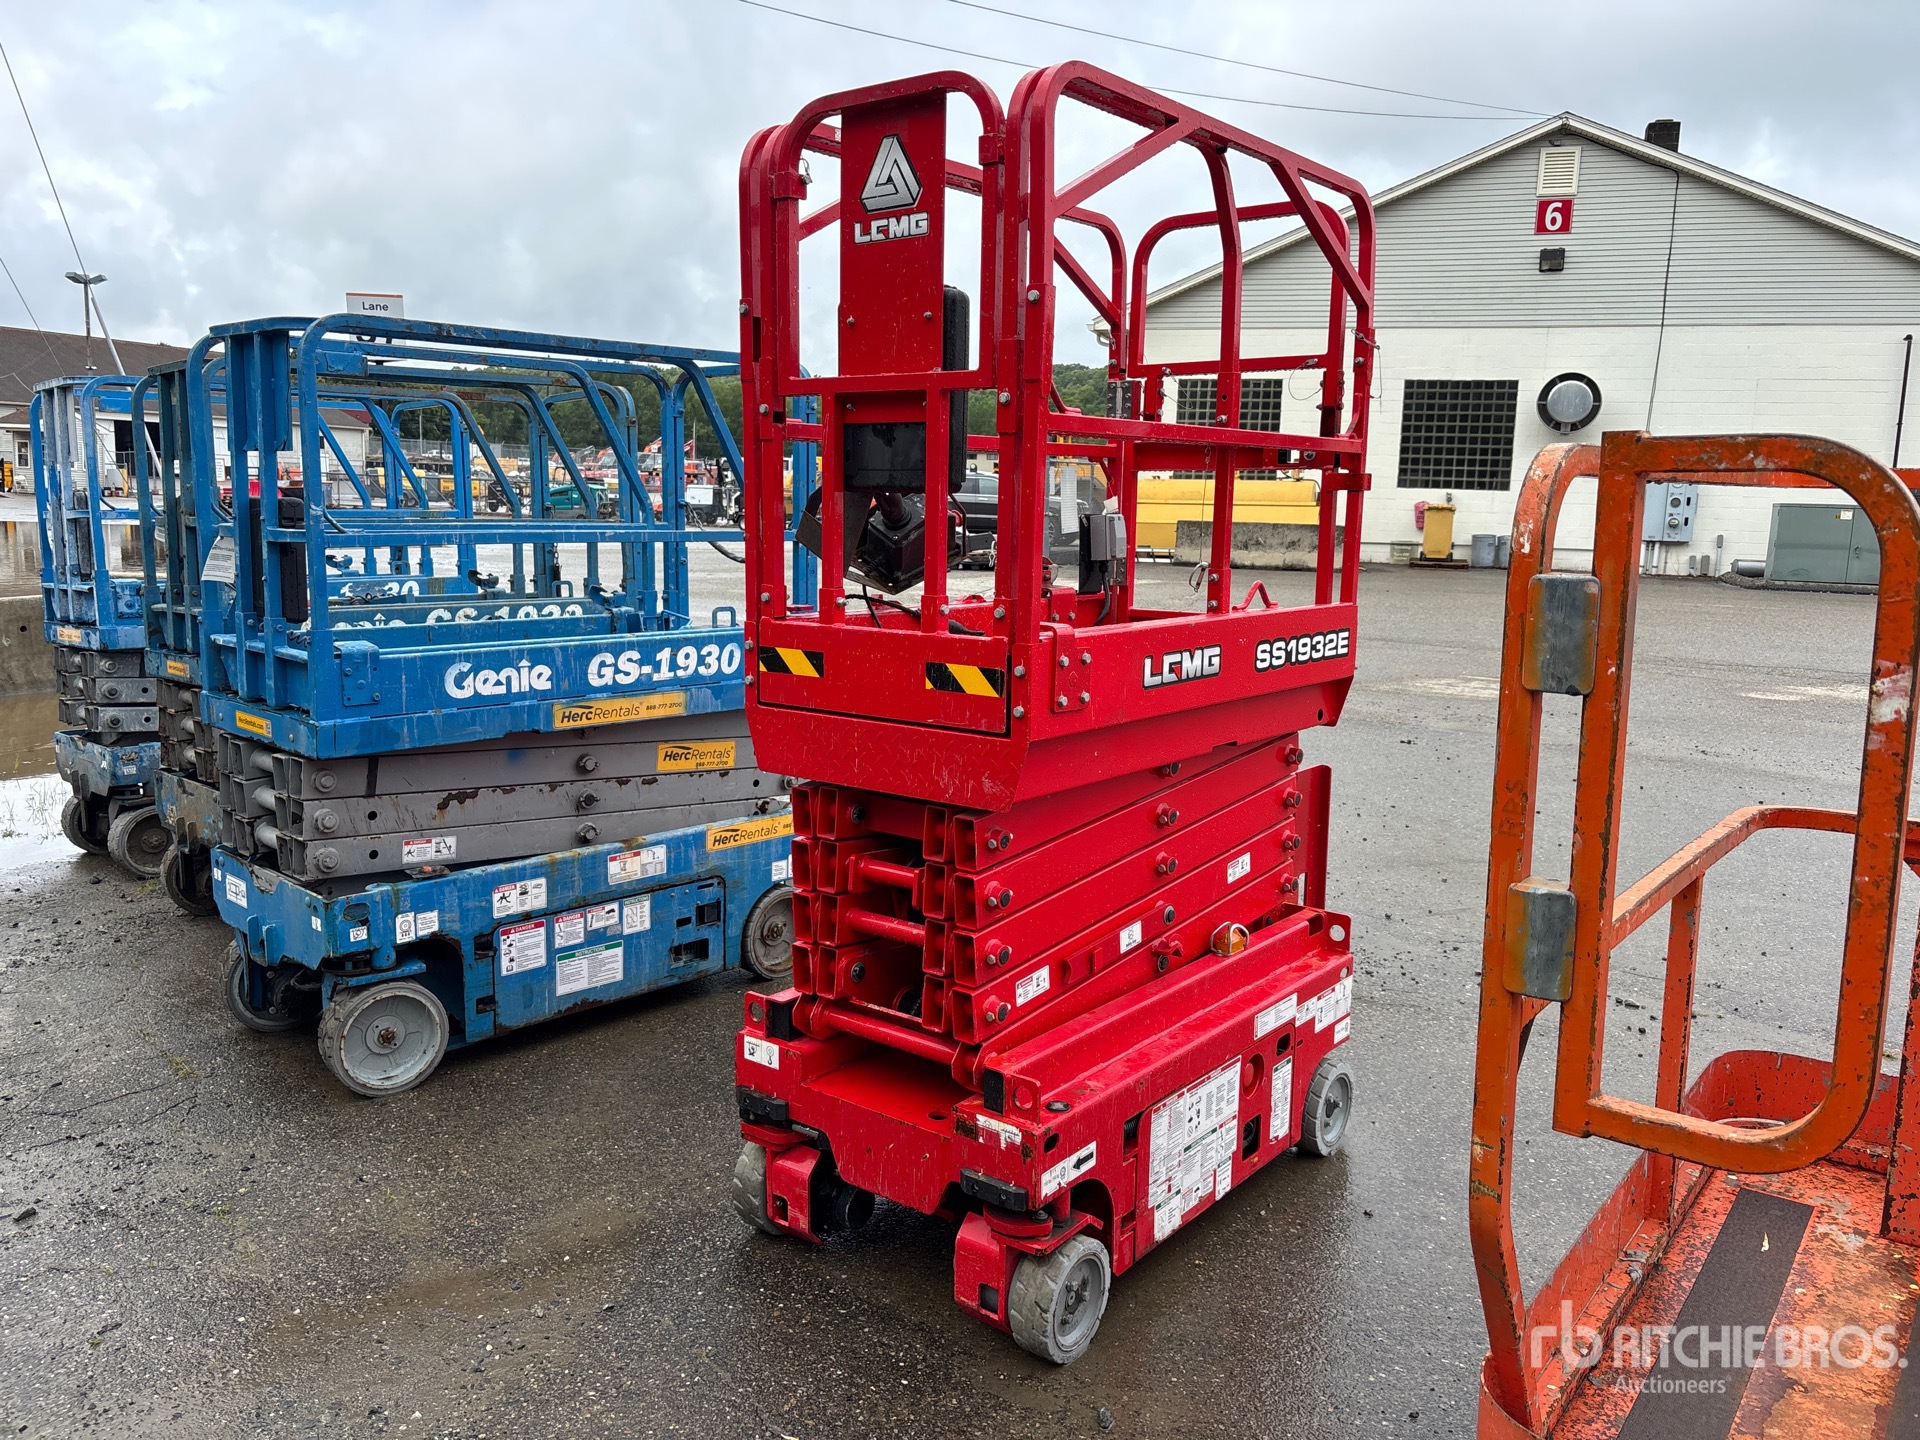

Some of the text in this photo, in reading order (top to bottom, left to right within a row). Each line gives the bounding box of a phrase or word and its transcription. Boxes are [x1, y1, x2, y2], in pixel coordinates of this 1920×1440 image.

[854, 212, 929, 244] LCMG
[1545, 201, 1563, 231] 6
[362, 301, 389, 311] Lane
[587, 643, 742, 687] GS-1930
[1144, 645, 1221, 687] LCMG
[1256, 631, 1350, 670] SS1932E
[444, 658, 552, 699] Genie
